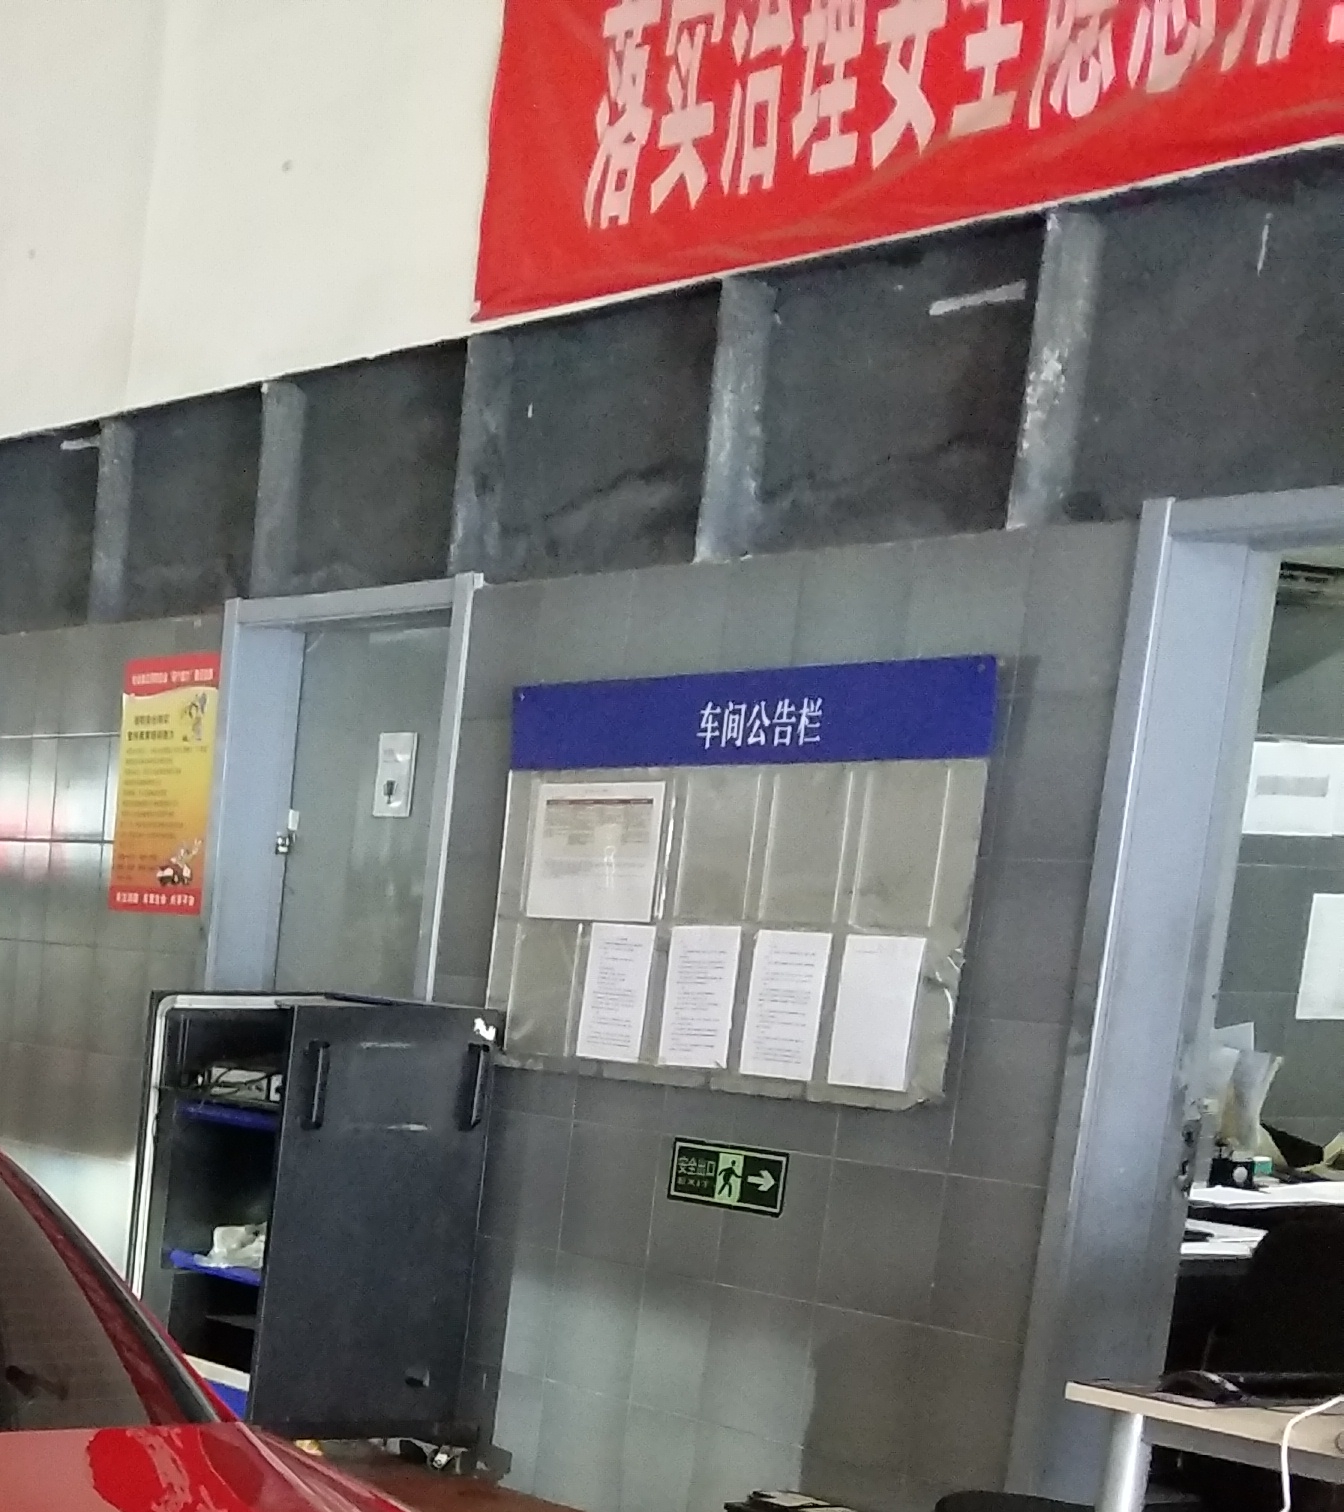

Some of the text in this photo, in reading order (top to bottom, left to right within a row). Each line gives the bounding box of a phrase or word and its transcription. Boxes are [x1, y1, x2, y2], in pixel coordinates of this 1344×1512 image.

[696, 697, 823, 750] 车间公告栏
[677, 1155, 716, 1177] 安全出口
[677, 1178, 708, 1188] EXIT
